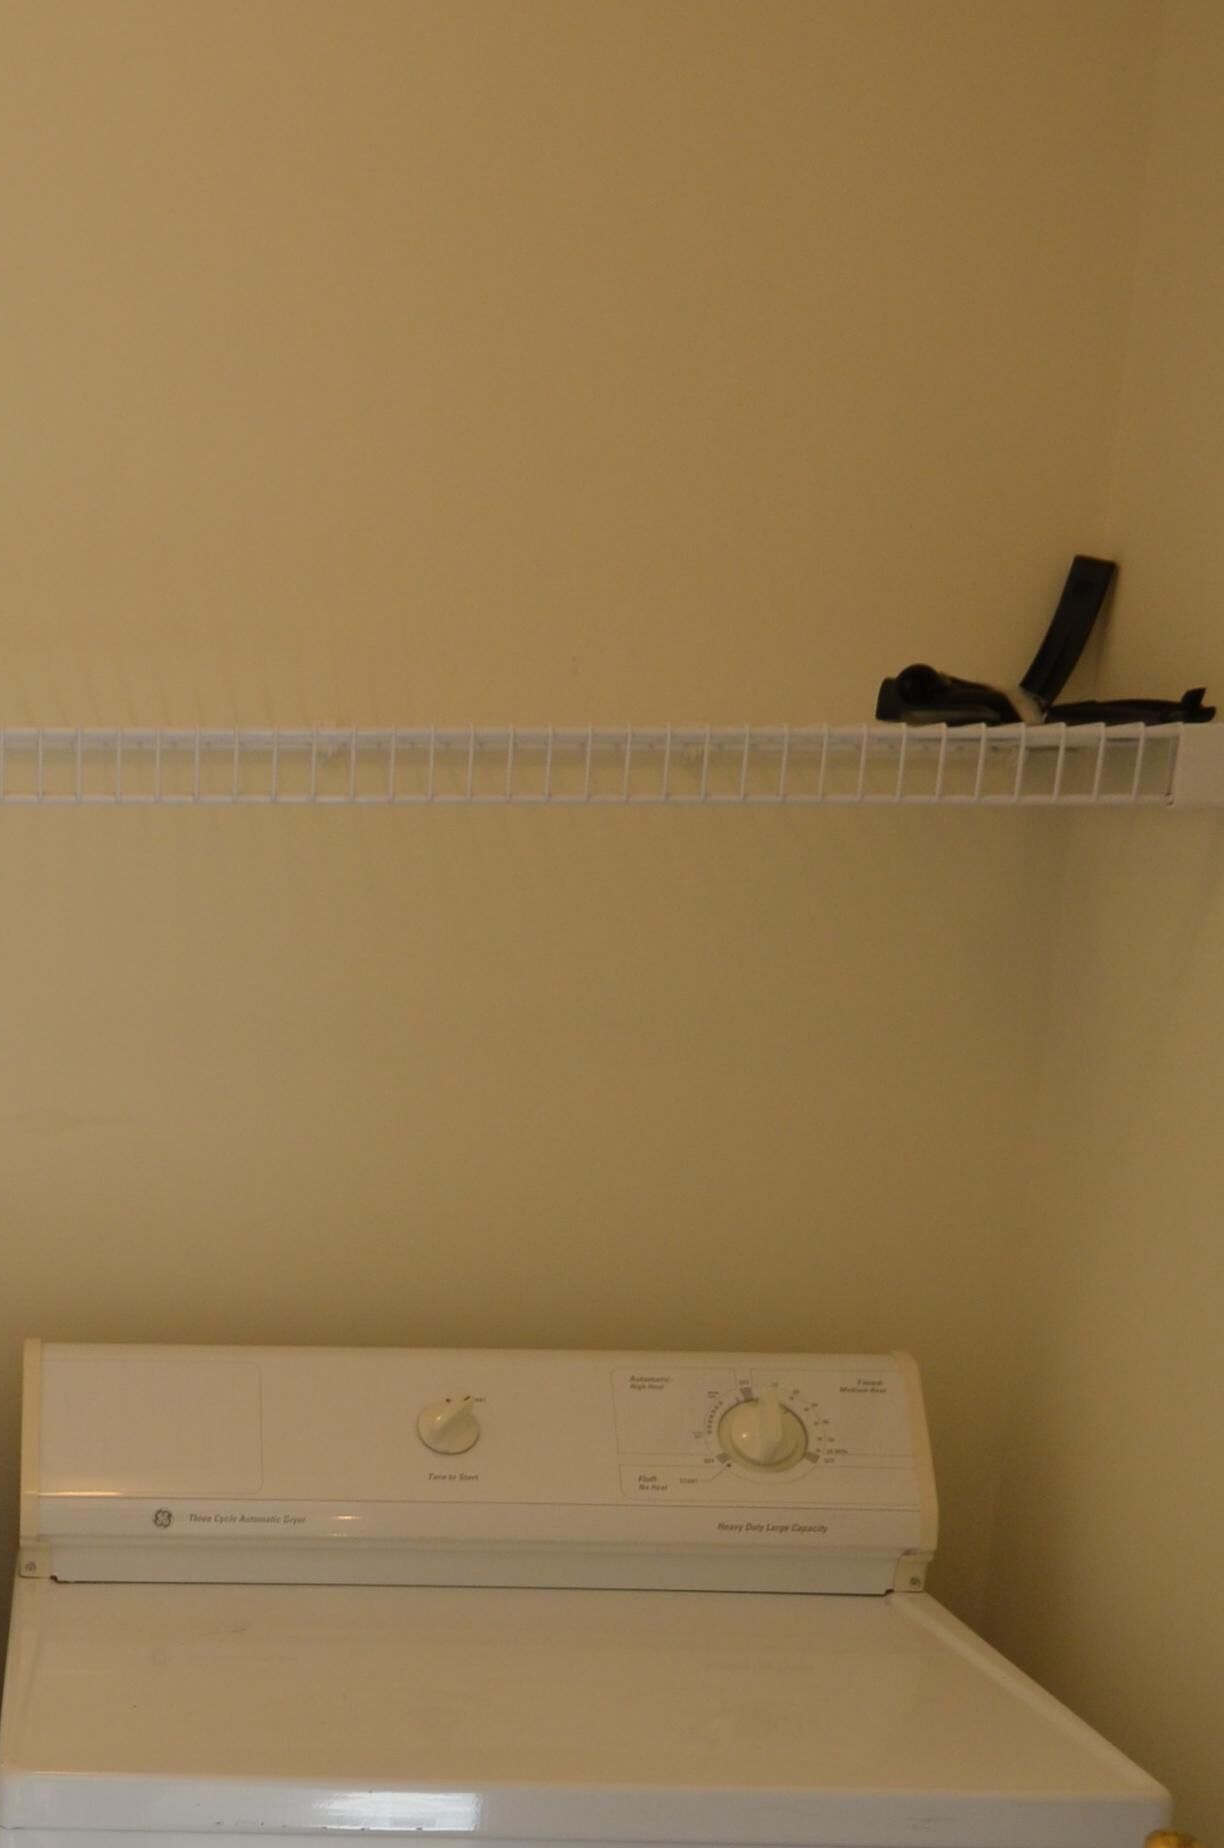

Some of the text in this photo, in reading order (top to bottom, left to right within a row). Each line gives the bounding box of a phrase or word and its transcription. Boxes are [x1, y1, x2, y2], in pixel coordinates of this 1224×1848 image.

[189, 1513, 307, 1525] Three Cycle Automatic Dryer
[717, 1522, 828, 1534] Heavy Duty Large Capacity
